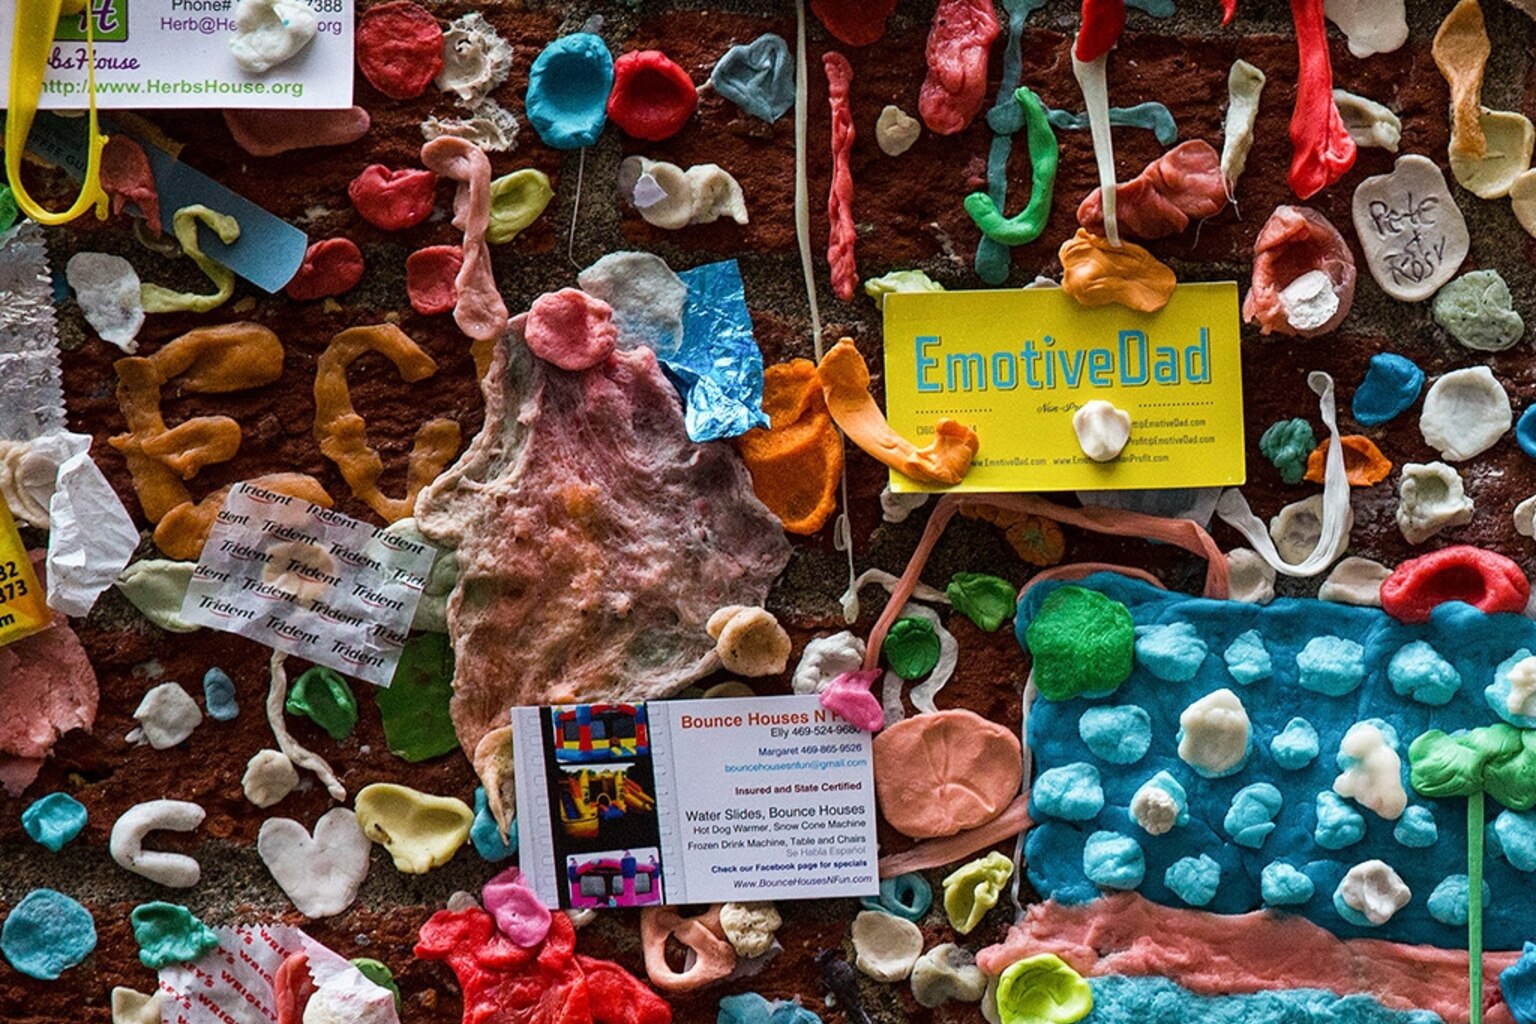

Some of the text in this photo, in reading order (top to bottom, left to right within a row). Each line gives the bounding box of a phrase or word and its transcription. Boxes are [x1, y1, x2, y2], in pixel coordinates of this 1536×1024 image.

[914, 327, 1211, 394] EmotiveDad
[217, 510, 251, 527] dent
[262, 519, 319, 547] Trident
[329, 541, 383, 572] Trident
[371, 527, 426, 556] Trident
[219, 539, 405, 612] Trident Trident Trident
[195, 565, 231, 584] dent
[242, 576, 300, 604] Trident
[309, 599, 364, 628] Trident
[200, 595, 384, 668] Trident Trident Trident
[681, 714, 743, 730] Bounce
[748, 711, 809, 726] Houses
[814, 709, 826, 723] N
[770, 727, 789, 740] Elly
[758, 747, 799, 759] Margaret
[735, 781, 862, 797] Insured and State Certified
[685, 804, 866, 822] Water Slides, Bounce Houses
[693, 819, 866, 836] Hot Dog Warmer, Snow Cone Machine
[687, 834, 866, 851] Frozen Drink Machine, Table and Chairs
[711, 859, 867, 874] Check our Facebook page for specials
[220, 970, 277, 1022] WRIGLEY
